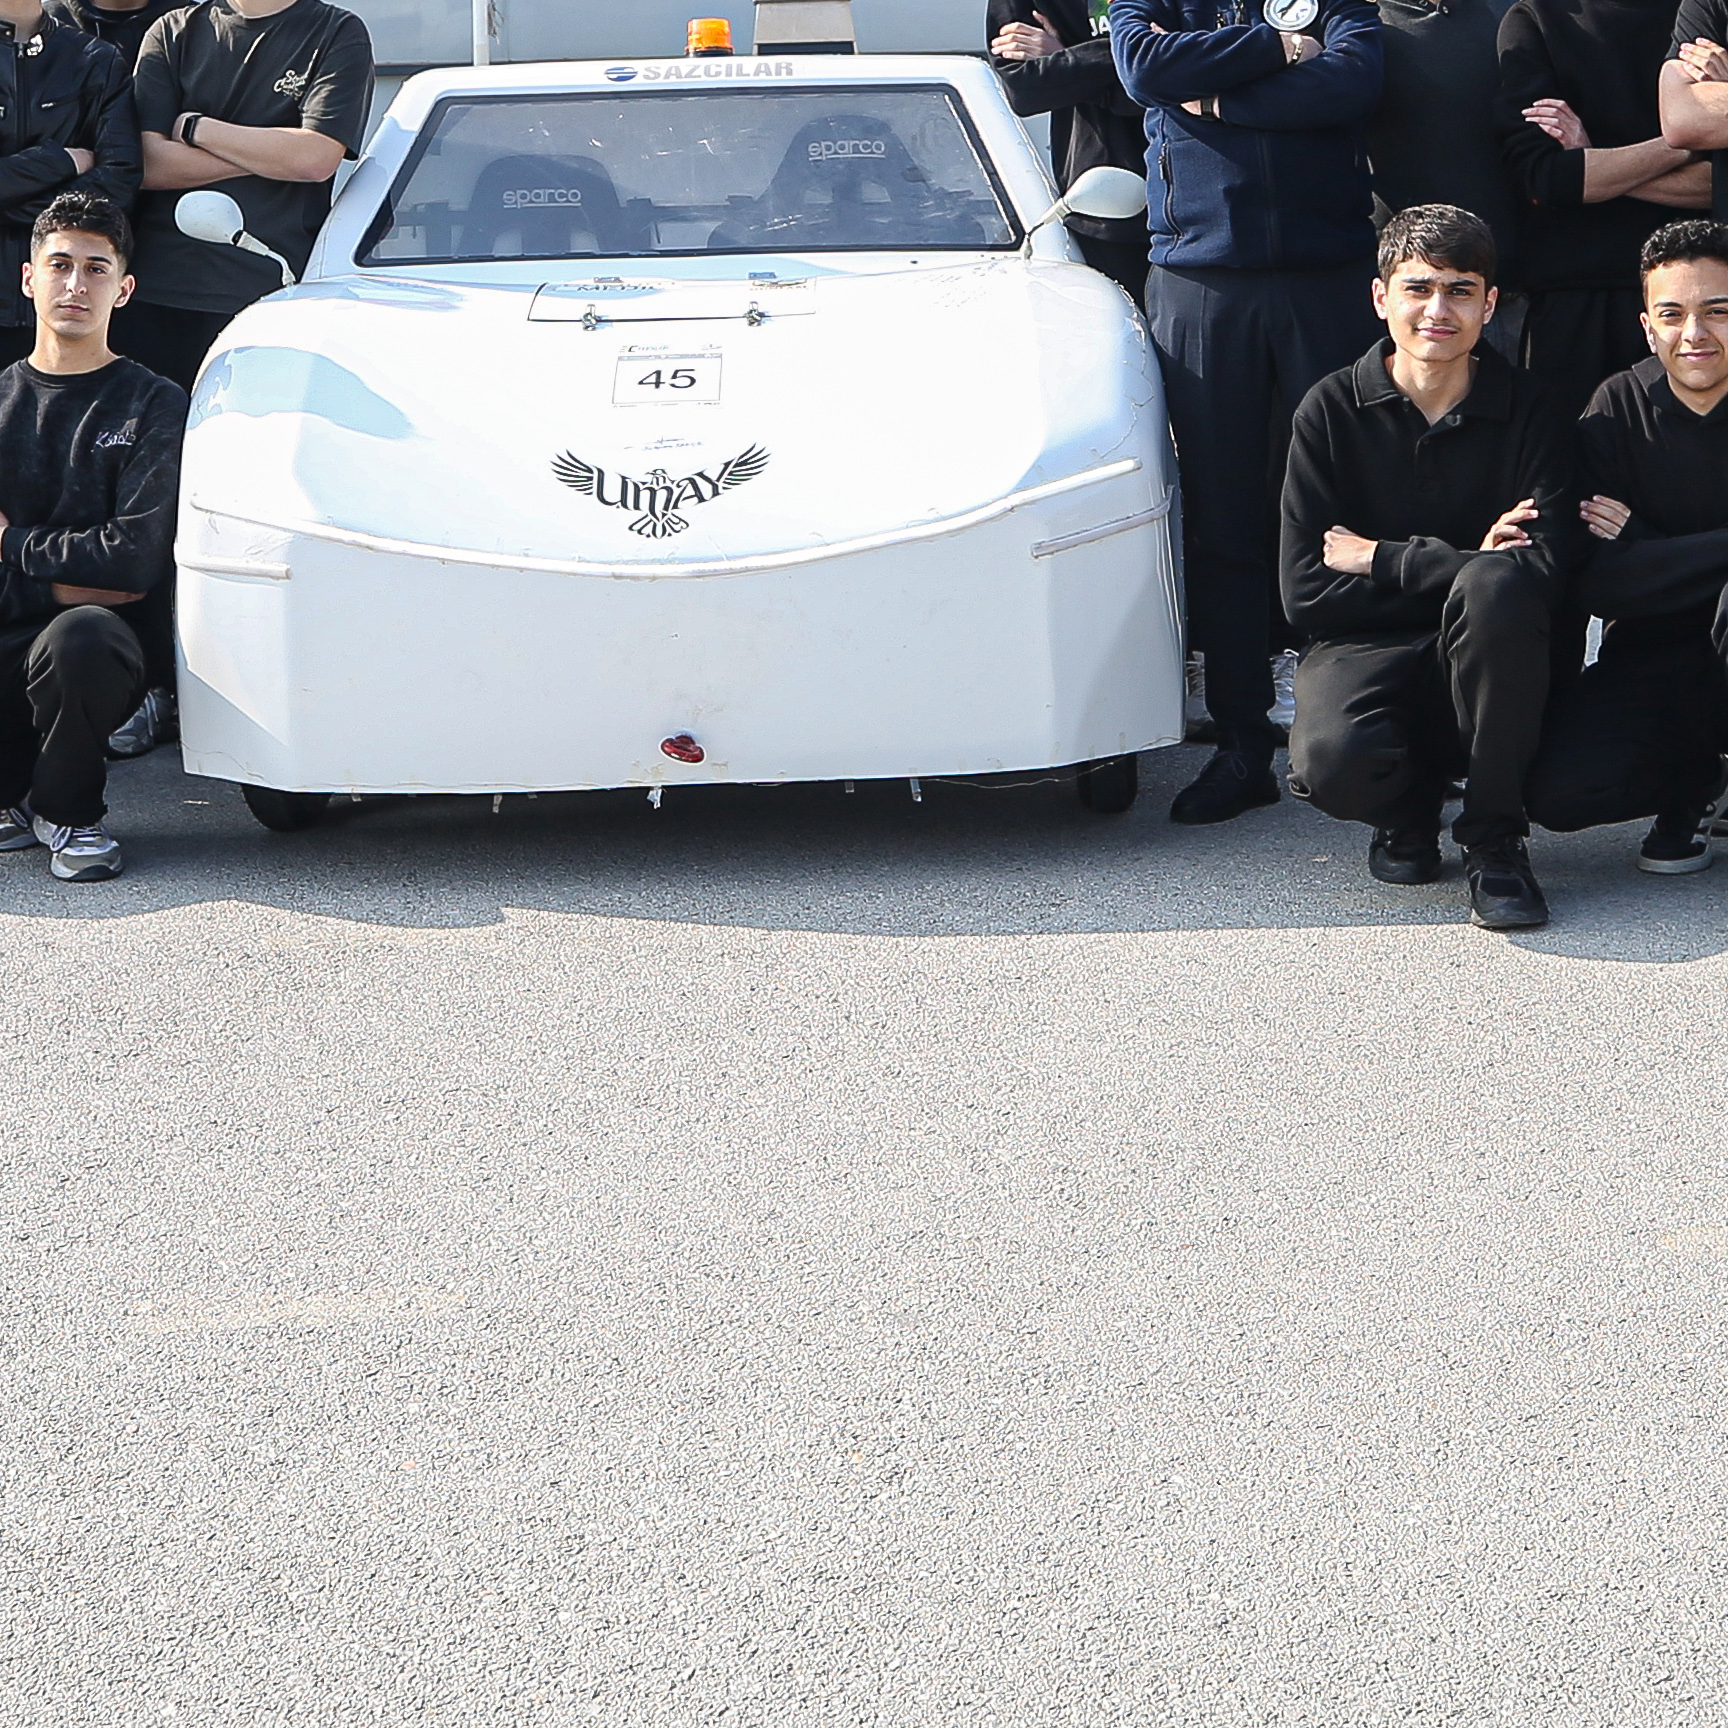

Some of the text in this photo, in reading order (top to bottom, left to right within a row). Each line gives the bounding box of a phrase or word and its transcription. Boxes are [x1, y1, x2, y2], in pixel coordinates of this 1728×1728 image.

[643, 61, 794, 80] SAZCILAR
[808, 140, 885, 160] sparco
[503, 188, 582, 208] sparco
[637, 368, 697, 390] 45
